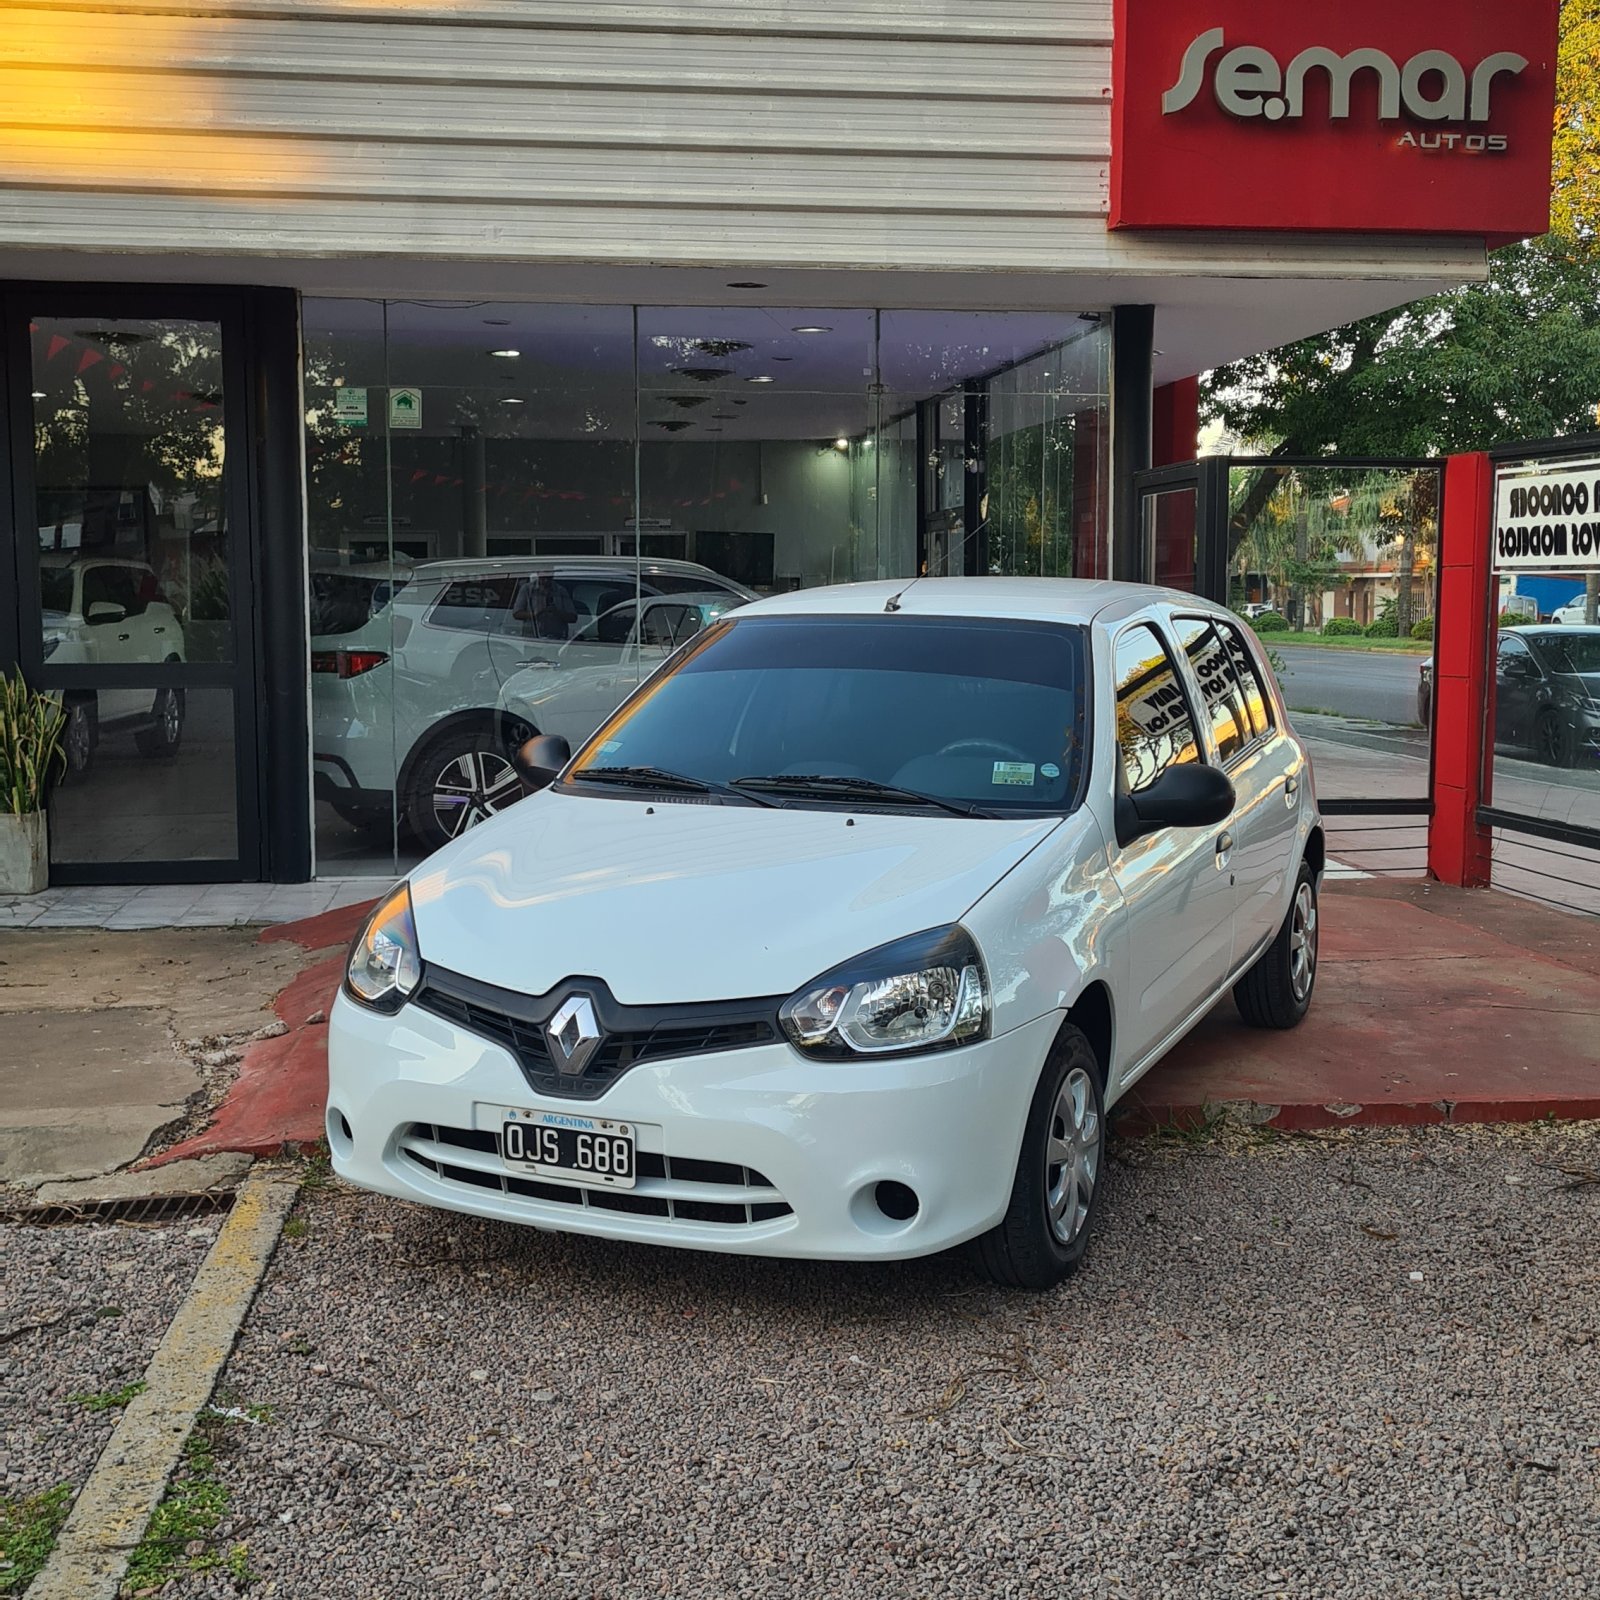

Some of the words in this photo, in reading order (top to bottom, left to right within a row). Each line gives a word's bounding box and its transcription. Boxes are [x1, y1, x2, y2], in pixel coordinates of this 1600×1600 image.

[1397, 130, 1508, 151] AUTOS
[543, 1077, 595, 1091] CLIO
[541, 1114, 595, 1130] ARGENTINA
[506, 1125, 559, 1164] OJS
[576, 1134, 628, 1174] 688
